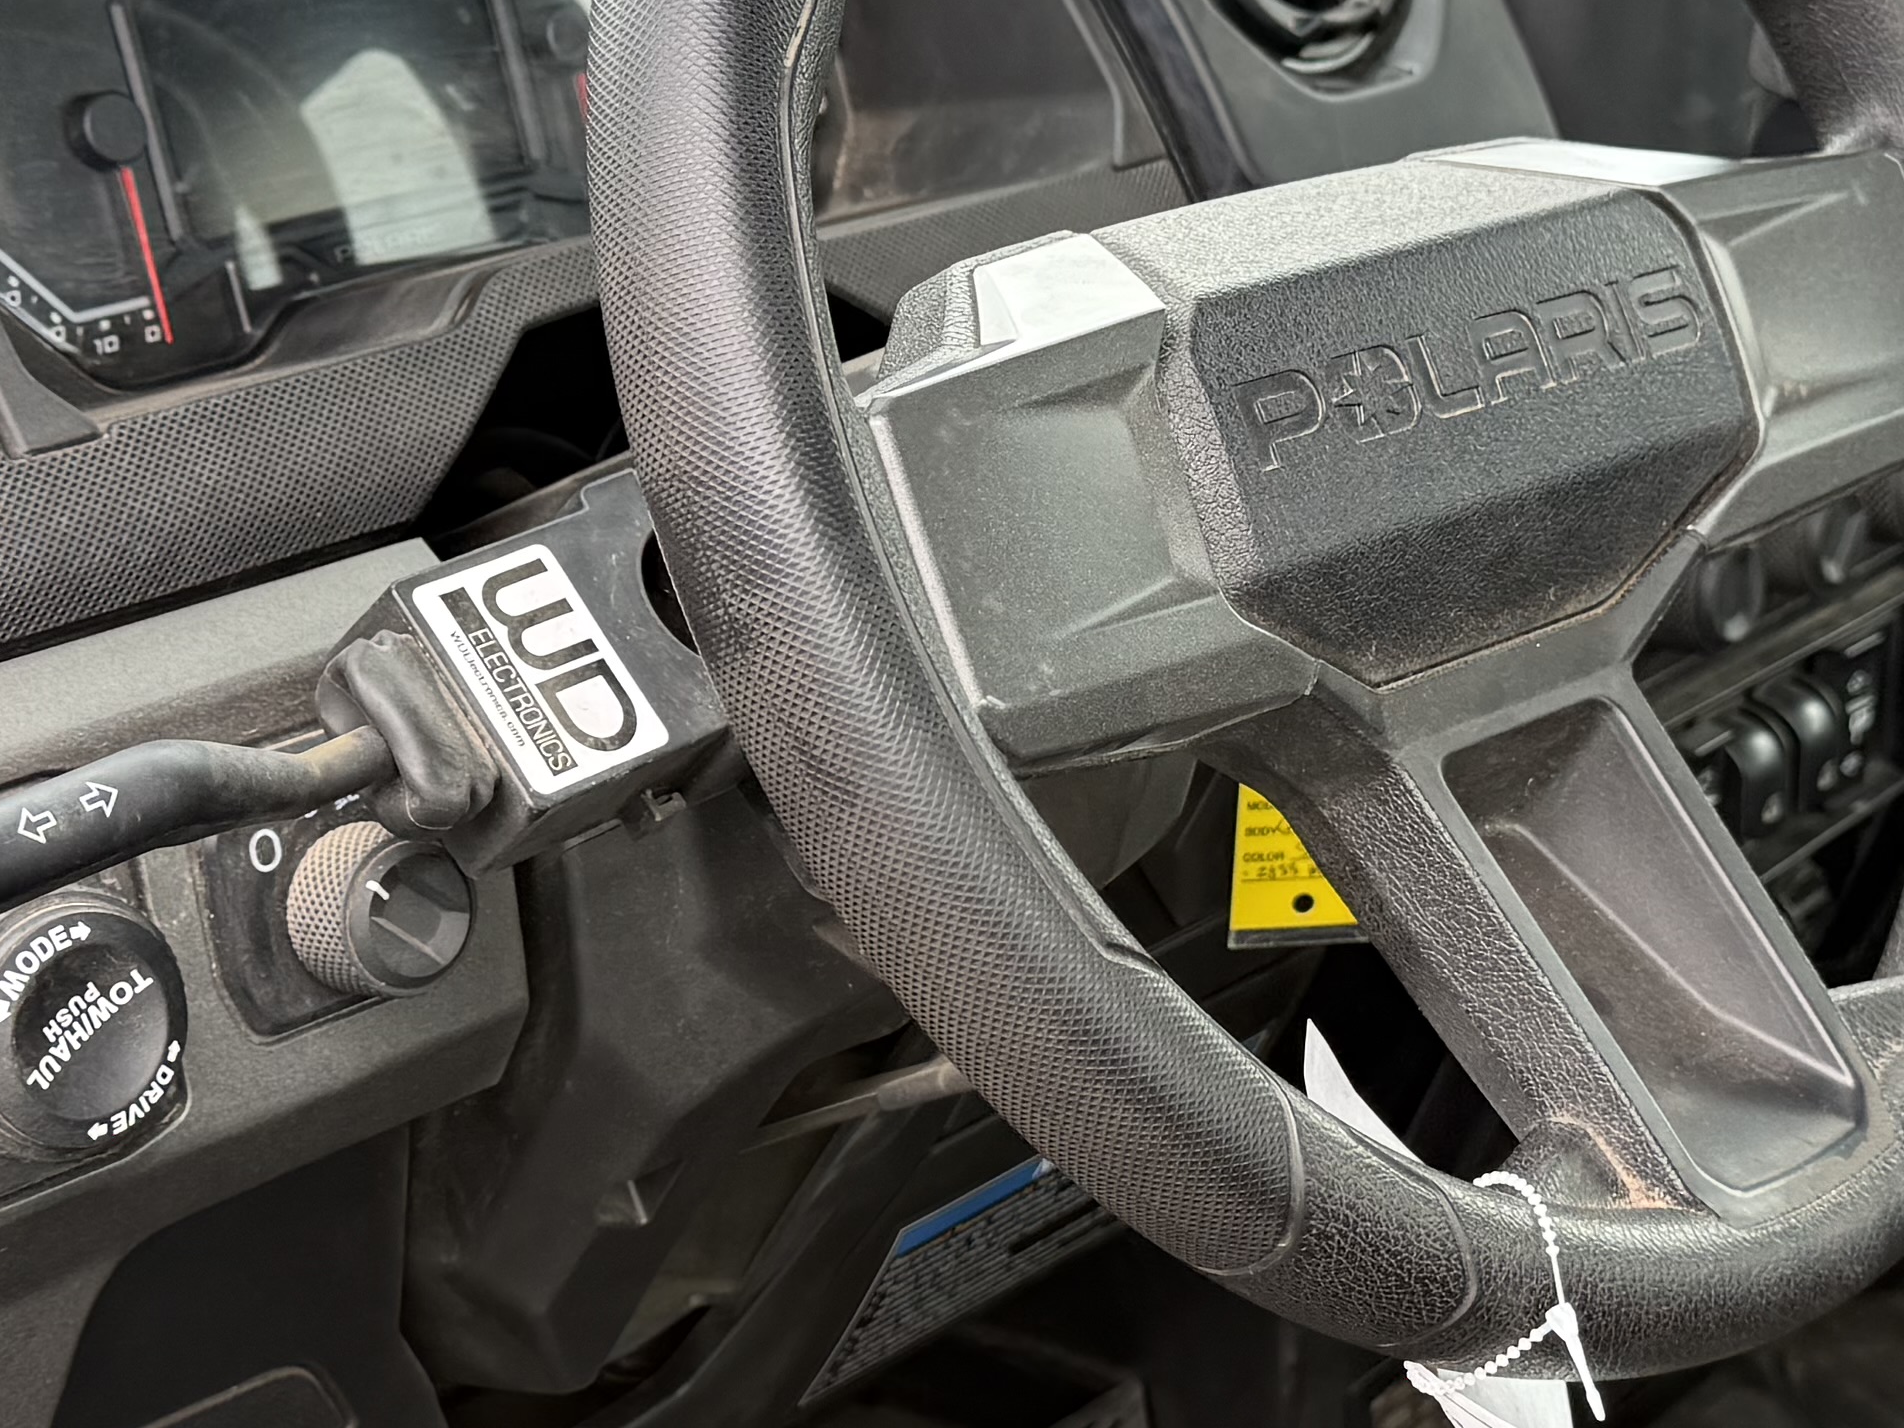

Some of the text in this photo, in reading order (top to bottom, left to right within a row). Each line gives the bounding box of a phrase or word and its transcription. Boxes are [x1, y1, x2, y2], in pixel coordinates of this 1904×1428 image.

[1226, 263, 1703, 473] POLARIS
[468, 627, 572, 773] ELECTRONICS
[26, 968, 154, 1090] TOW/HAUL
[42, 981, 101, 1043] PUSH
[110, 1063, 175, 1135] DRIVE
